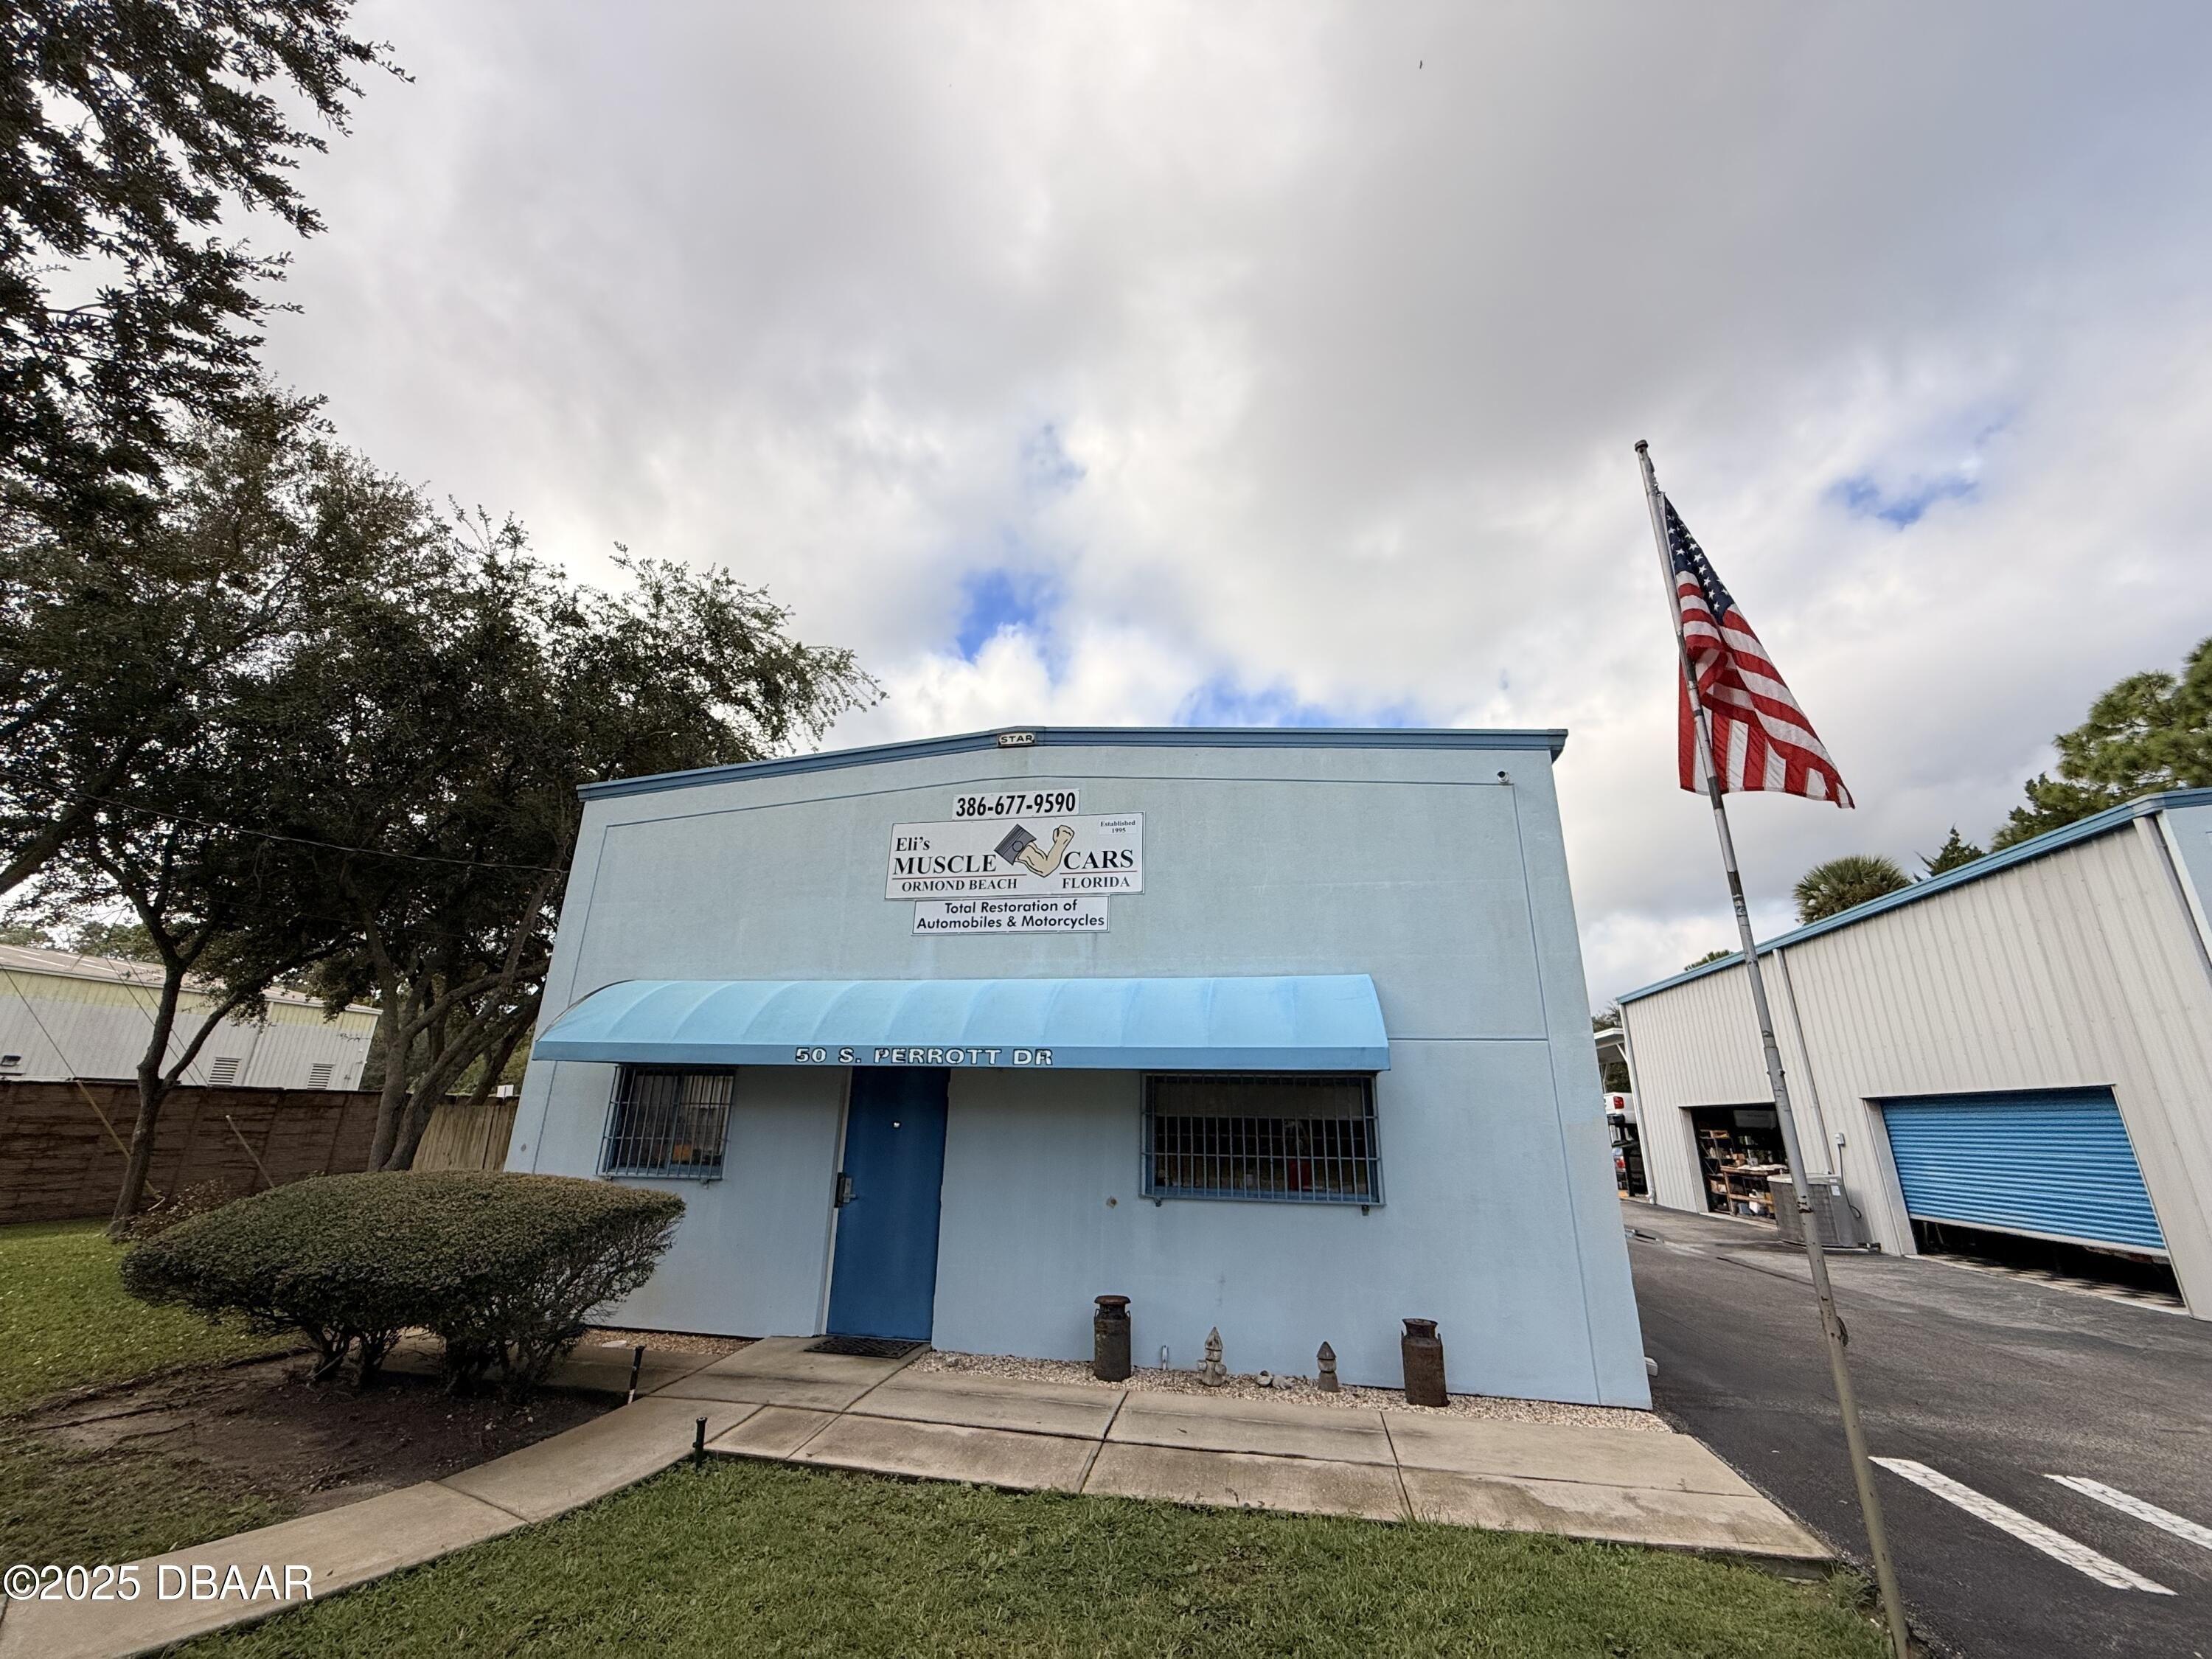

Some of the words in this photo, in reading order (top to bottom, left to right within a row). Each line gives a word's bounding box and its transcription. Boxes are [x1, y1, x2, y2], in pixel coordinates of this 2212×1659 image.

[1001, 734, 1033, 743] STAR
[956, 792, 1076, 817] 386-677-9590
[896, 836, 930, 852] Eli's
[893, 854, 997, 874] MUSCLE
[1063, 849, 1134, 870] CARS
[902, 880, 965, 892] ORMOND
[969, 878, 1018, 890] BEACH
[1062, 876, 1130, 889] FLORIDA
[945, 901, 976, 914] Total
[981, 900, 1058, 914] Restoration
[1063, 899, 1078, 911] of
[917, 915, 1002, 929] Automobiles
[1007, 916, 1017, 928] &
[1021, 914, 1105, 929] Motorcycles
[795, 1047, 827, 1063] 50
[838, 1047, 862, 1064] S.
[874, 1048, 1001, 1065] PERROTT
[1013, 1048, 1054, 1066] DR
